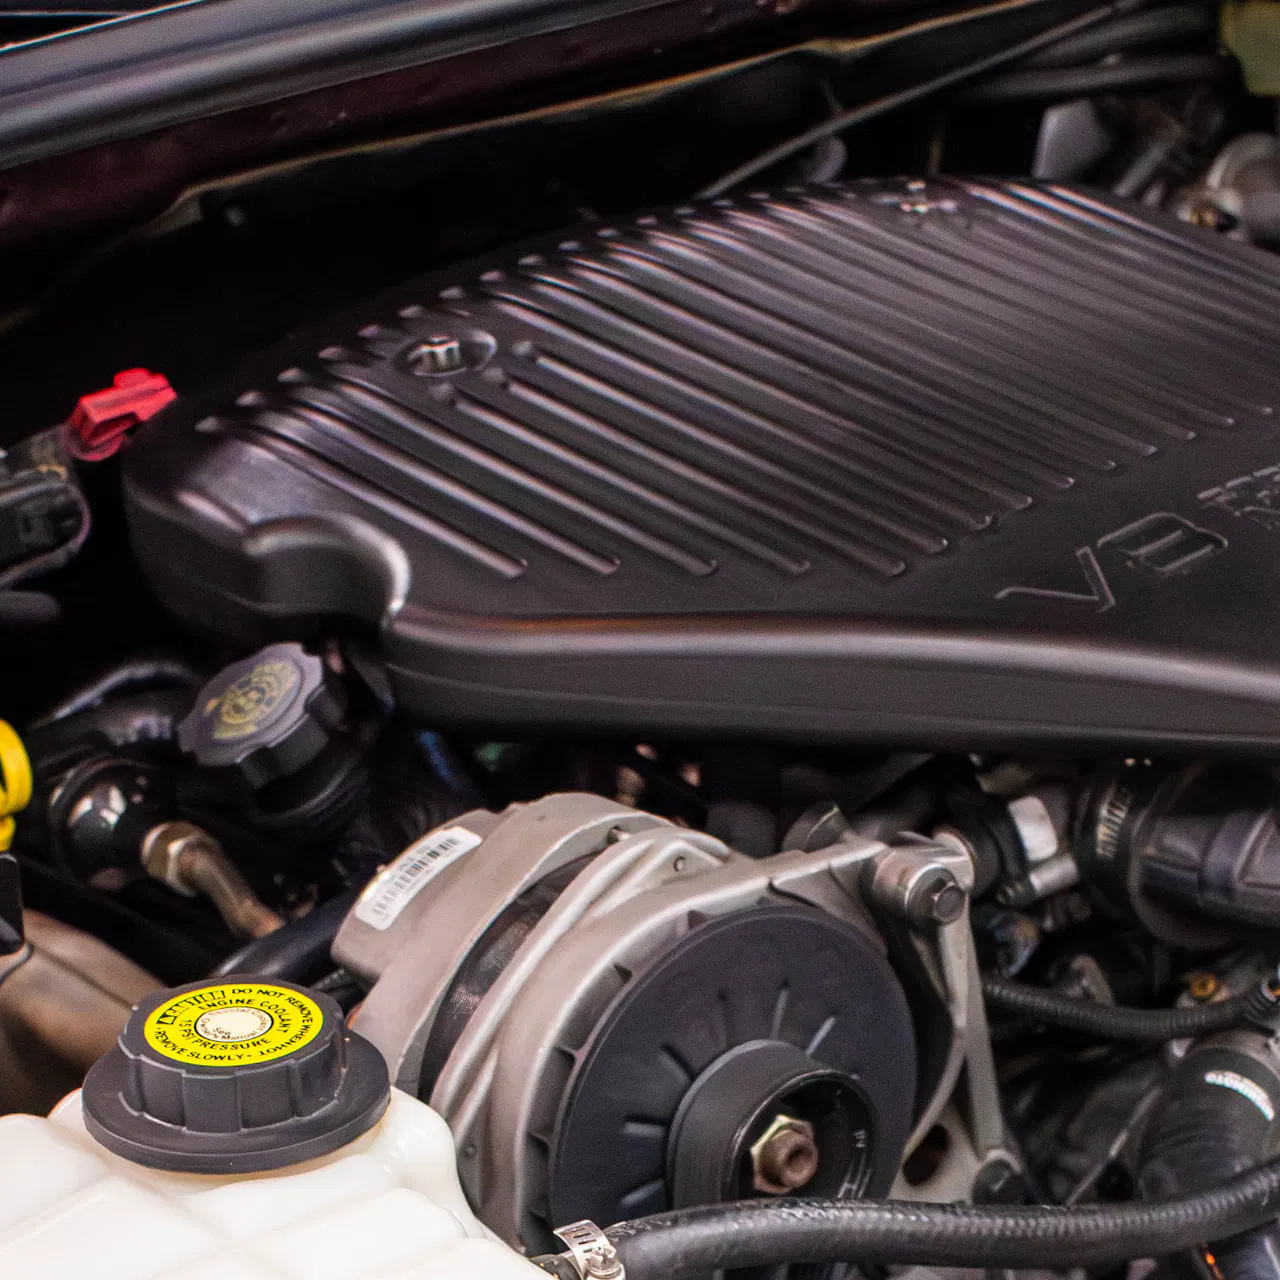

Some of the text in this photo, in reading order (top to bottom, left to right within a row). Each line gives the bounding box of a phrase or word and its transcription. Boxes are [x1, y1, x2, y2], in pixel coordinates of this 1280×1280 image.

[257, 989, 285, 998] NOT
[198, 999, 292, 1033] ENGINE COOLANT
[285, 996, 312, 1023] REMOVE
[181, 1028, 193, 1041] PSI
[193, 1038, 271, 1050] PRESSURE
[288, 1024, 310, 1044] WHEN
[155, 1030, 243, 1061] REMOVE SLOWLY
[259, 1043, 287, 1056] HOT
